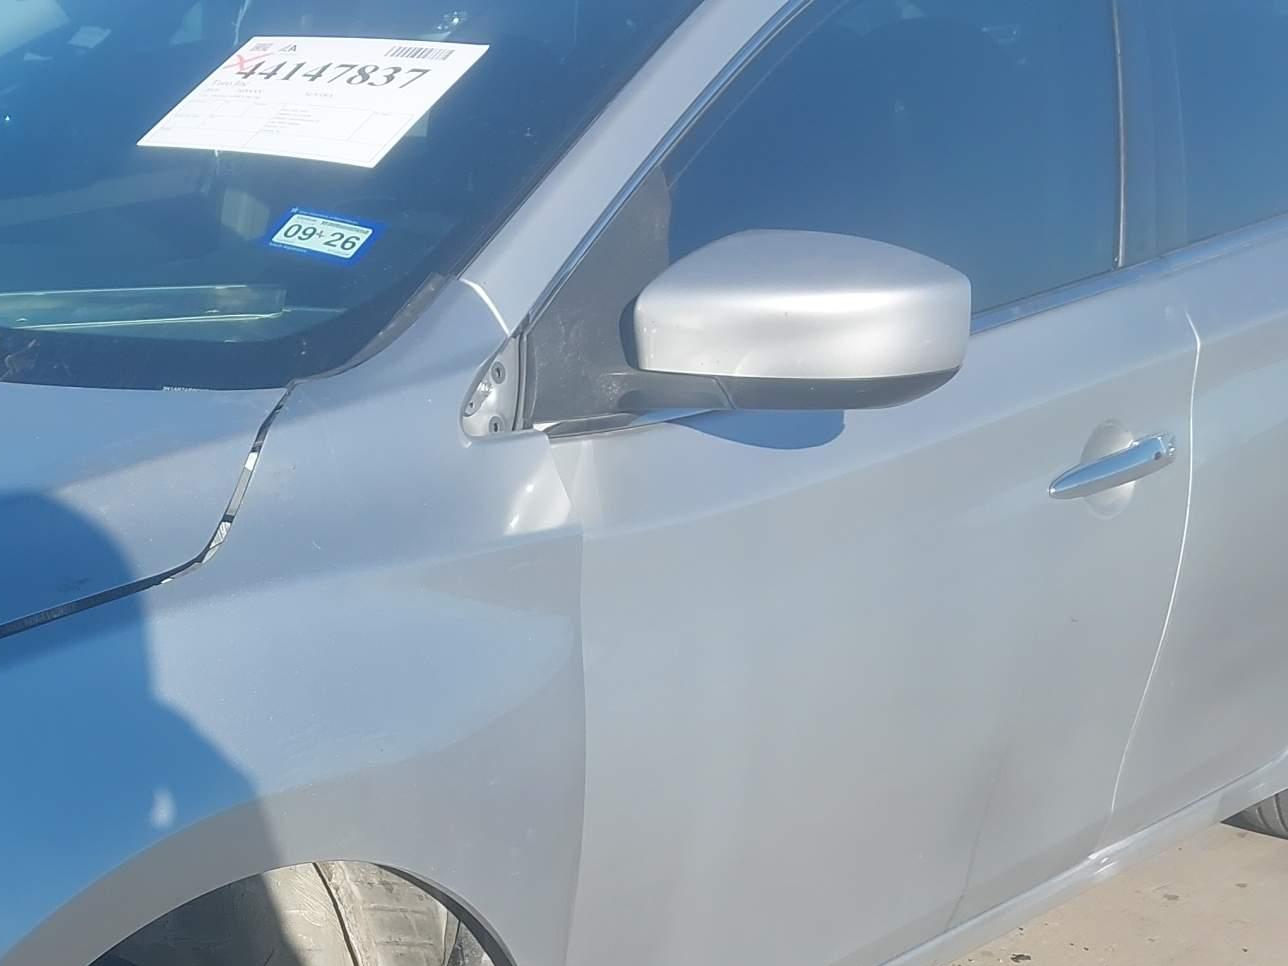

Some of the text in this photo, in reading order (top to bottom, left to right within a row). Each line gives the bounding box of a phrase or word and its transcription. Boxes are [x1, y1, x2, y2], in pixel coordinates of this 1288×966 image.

[237, 60, 431, 88] 44147837
[283, 223, 317, 241] 09
[323, 232, 361, 251] 26
